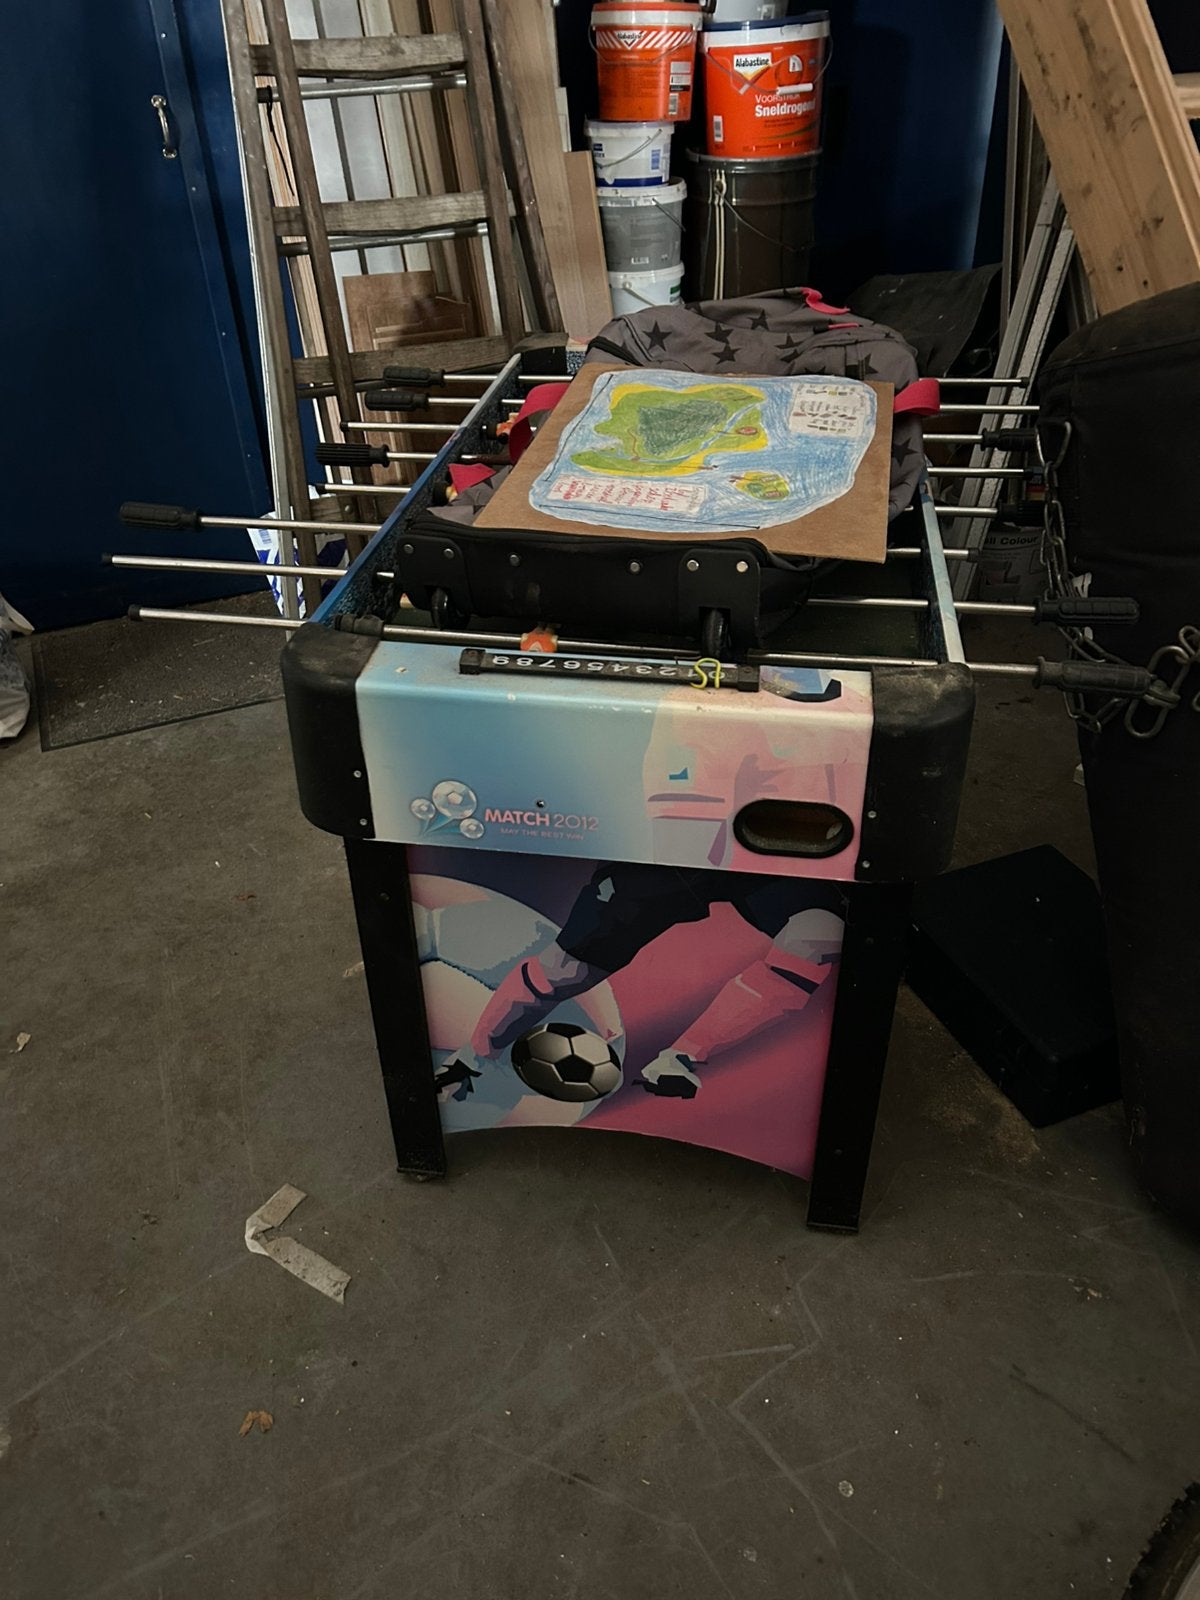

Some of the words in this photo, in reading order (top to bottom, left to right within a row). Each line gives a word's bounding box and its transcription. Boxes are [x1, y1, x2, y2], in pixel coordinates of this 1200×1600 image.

[735, 56, 770, 67] Alabastine
[1000, 535, 1039, 545] Colour
[485, 808, 549, 826] MATCH
[554, 814, 599, 831] 2012
[500, 827, 518, 835] MAY
[522, 829, 537, 837] THE
[541, 831, 564, 839] BEST
